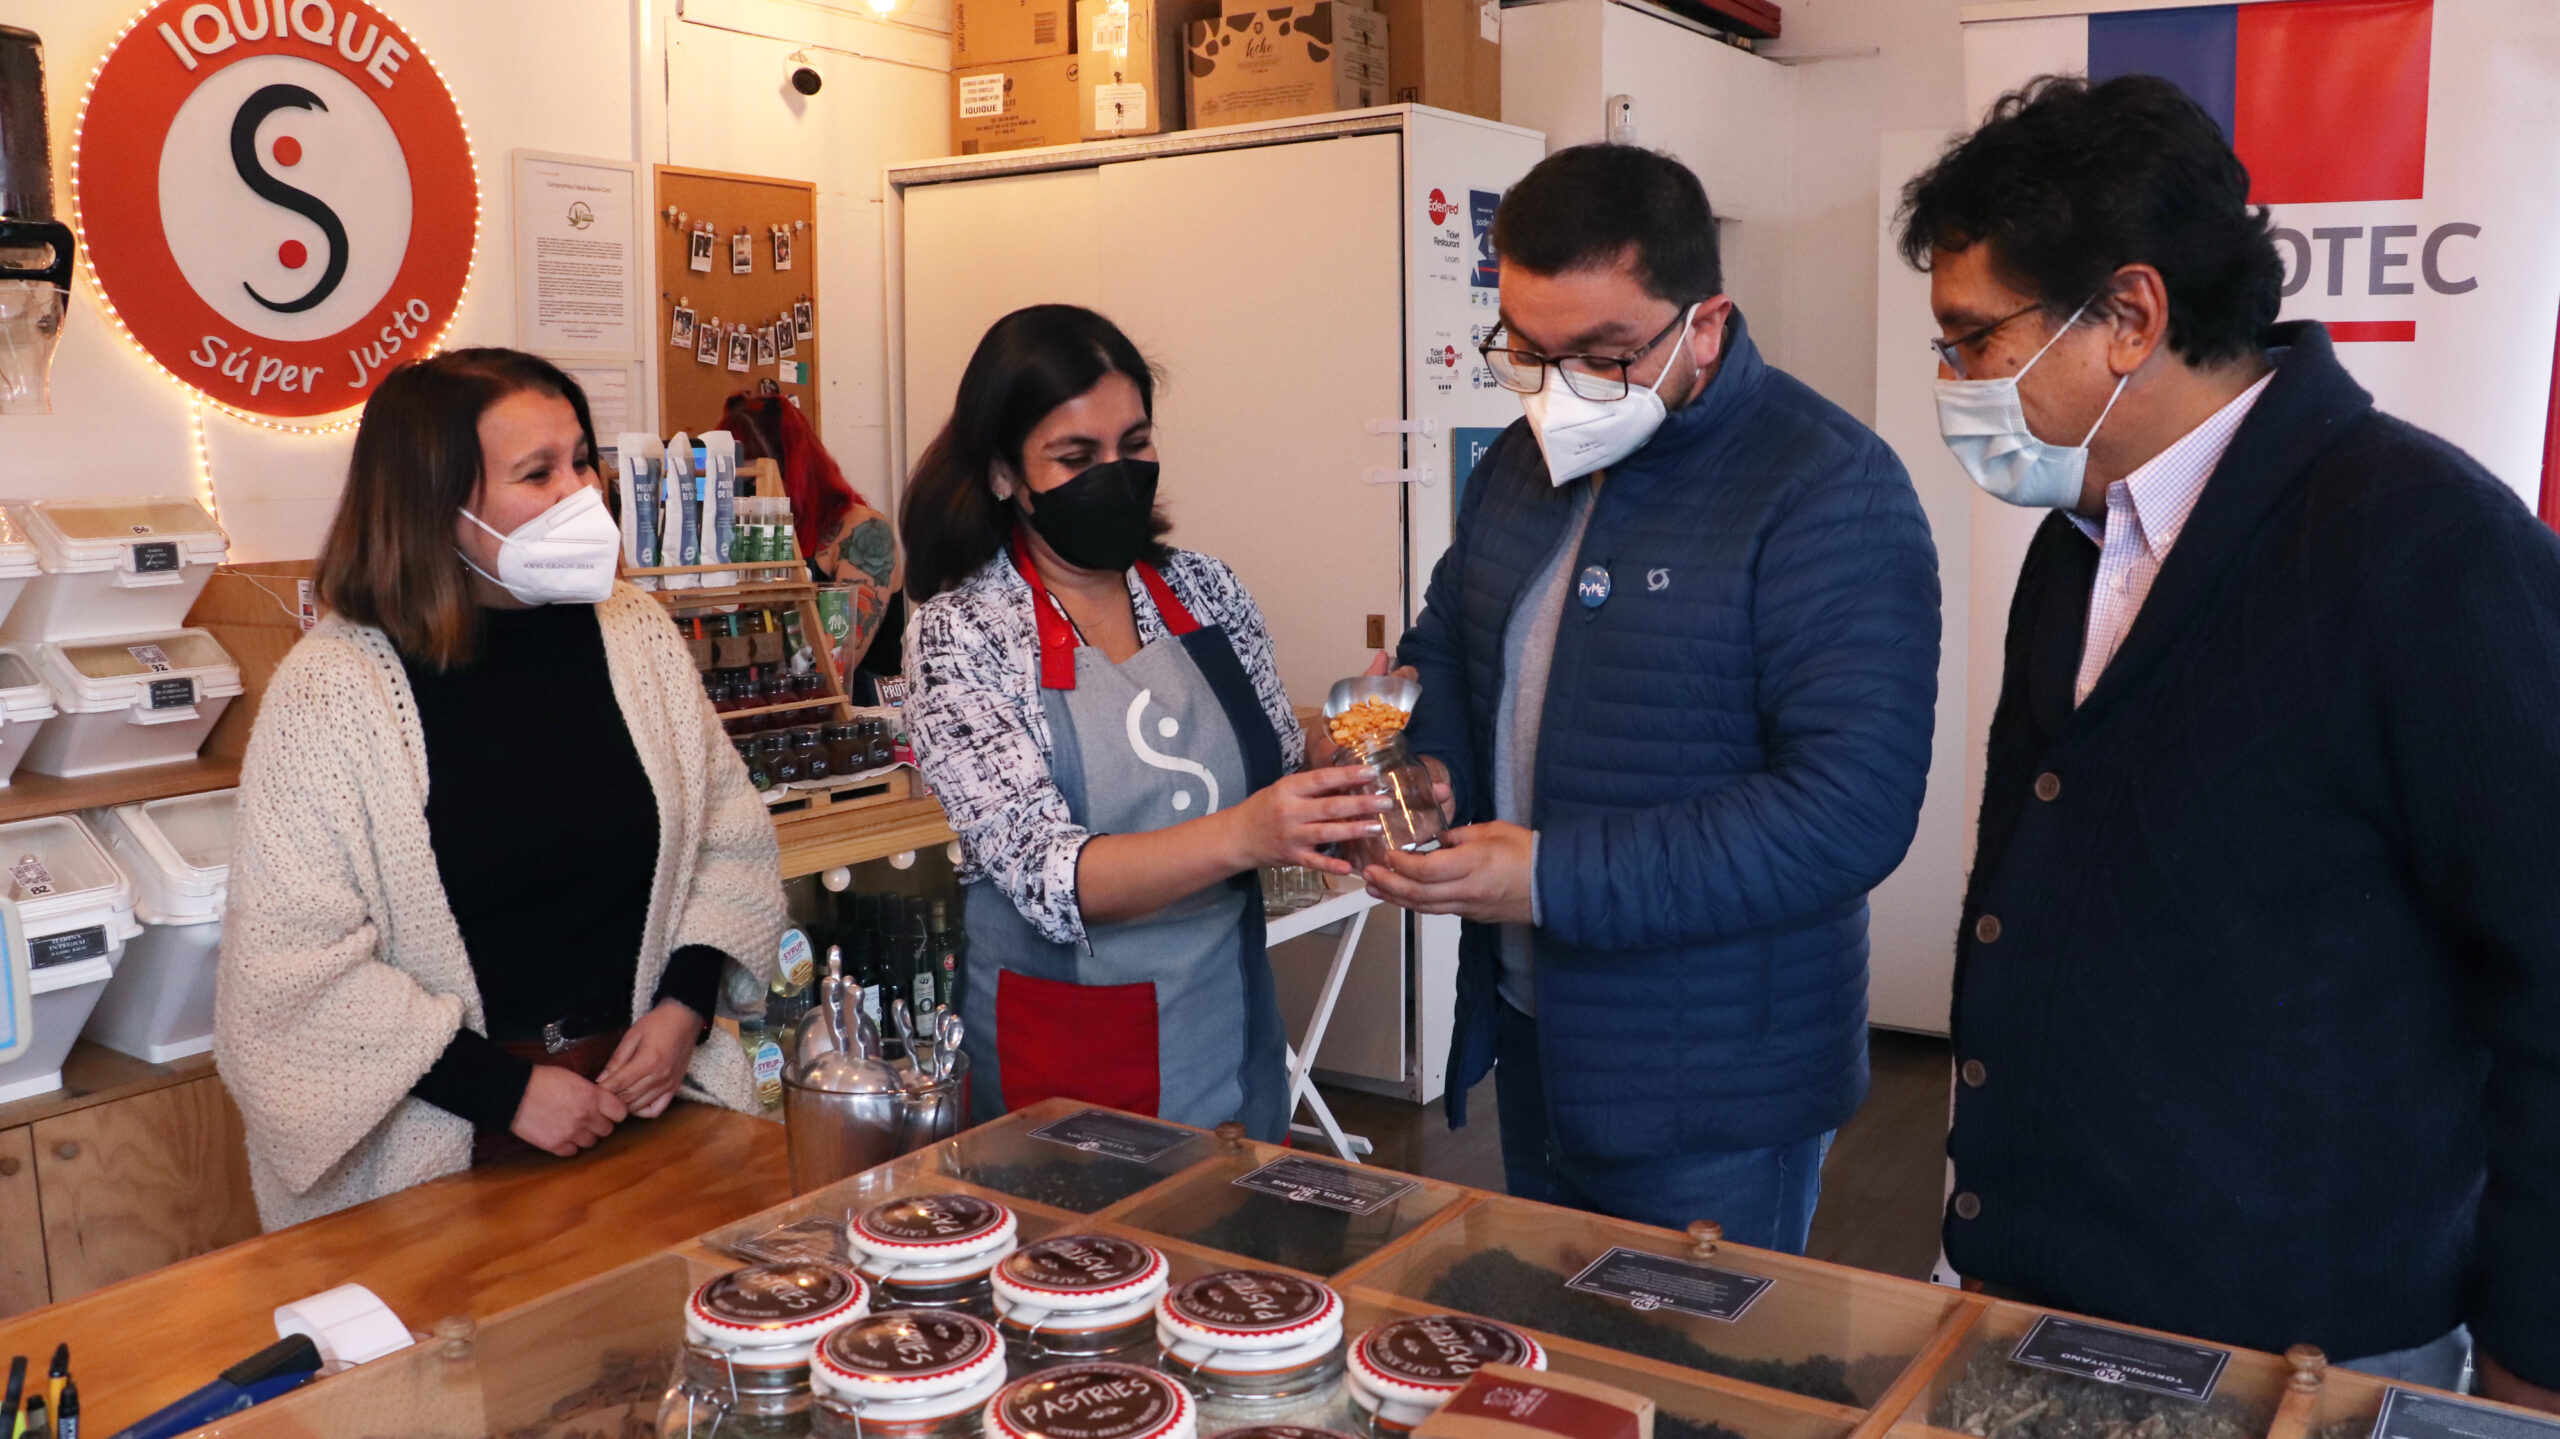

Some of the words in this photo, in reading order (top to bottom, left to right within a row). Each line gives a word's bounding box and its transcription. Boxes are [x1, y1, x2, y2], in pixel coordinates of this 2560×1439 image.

[157, 0, 410, 89] IQUIQUE
[965, 104, 997, 115] IQUIQUE
[1429, 198, 1459, 215] Edenred
[1434, 237, 1460, 248] Restaurant
[1446, 230, 1460, 239] Ticket
[189, 335, 324, 396] Súper
[348, 298, 430, 388] Justo
[1579, 582, 1606, 597] PYME
[783, 940, 804, 961] SYRUP
[757, 1059, 780, 1071] SYRUP
[2060, 1352, 2117, 1369] CUYANO
[2120, 1364, 2184, 1384] TORONJIL
[1020, 1378, 1152, 1426] PASTRIES
